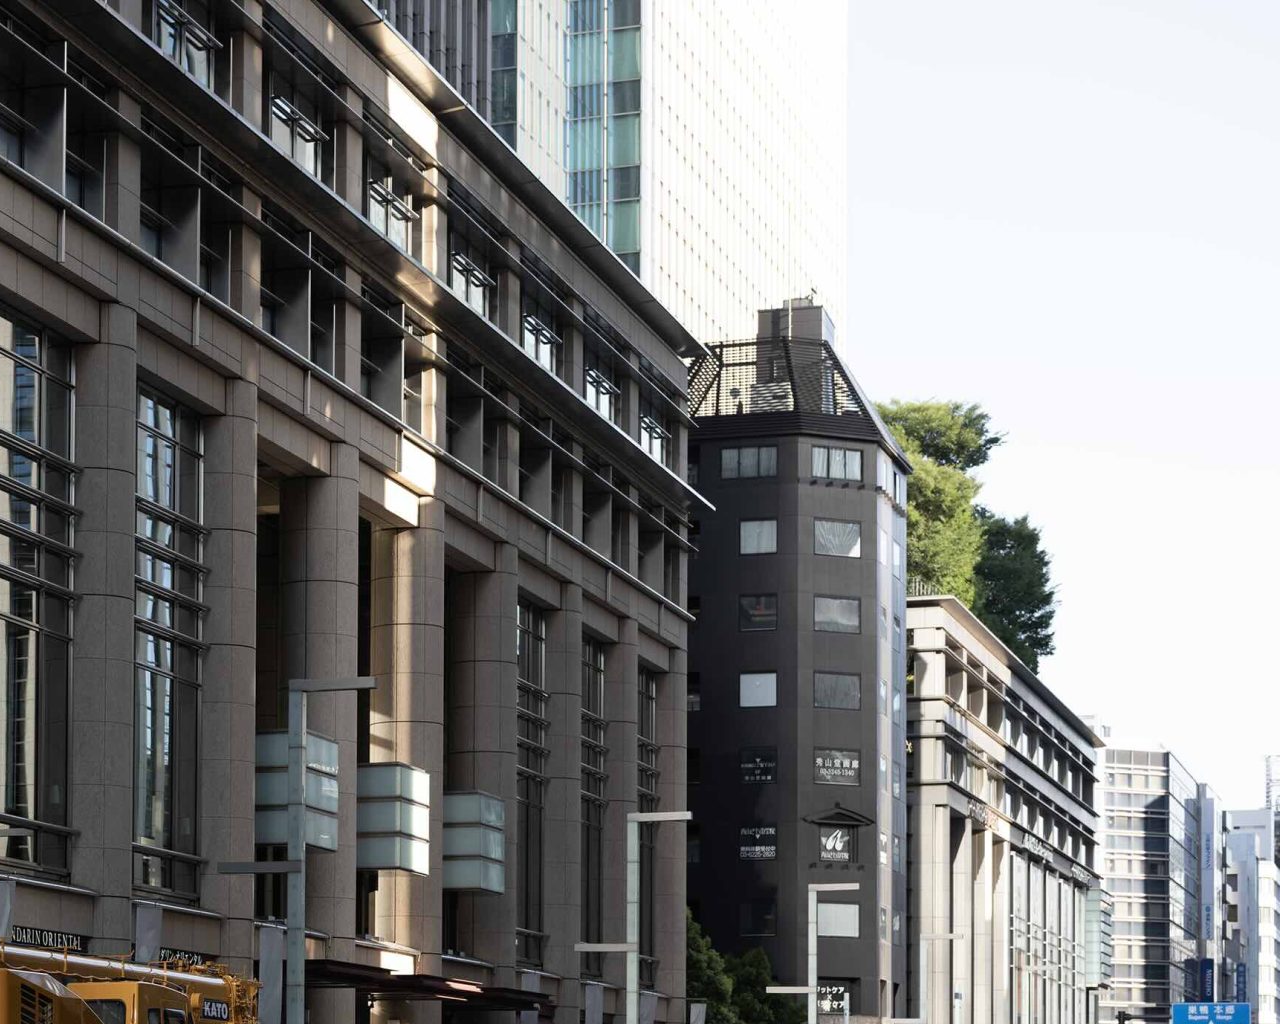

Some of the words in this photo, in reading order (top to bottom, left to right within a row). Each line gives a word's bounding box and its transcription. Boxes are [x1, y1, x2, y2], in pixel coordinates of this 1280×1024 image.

[12, 926, 41, 946] NDARIN
[42, 931, 82, 951] ORIENTAL
[204, 1001, 228, 1020] KATO
